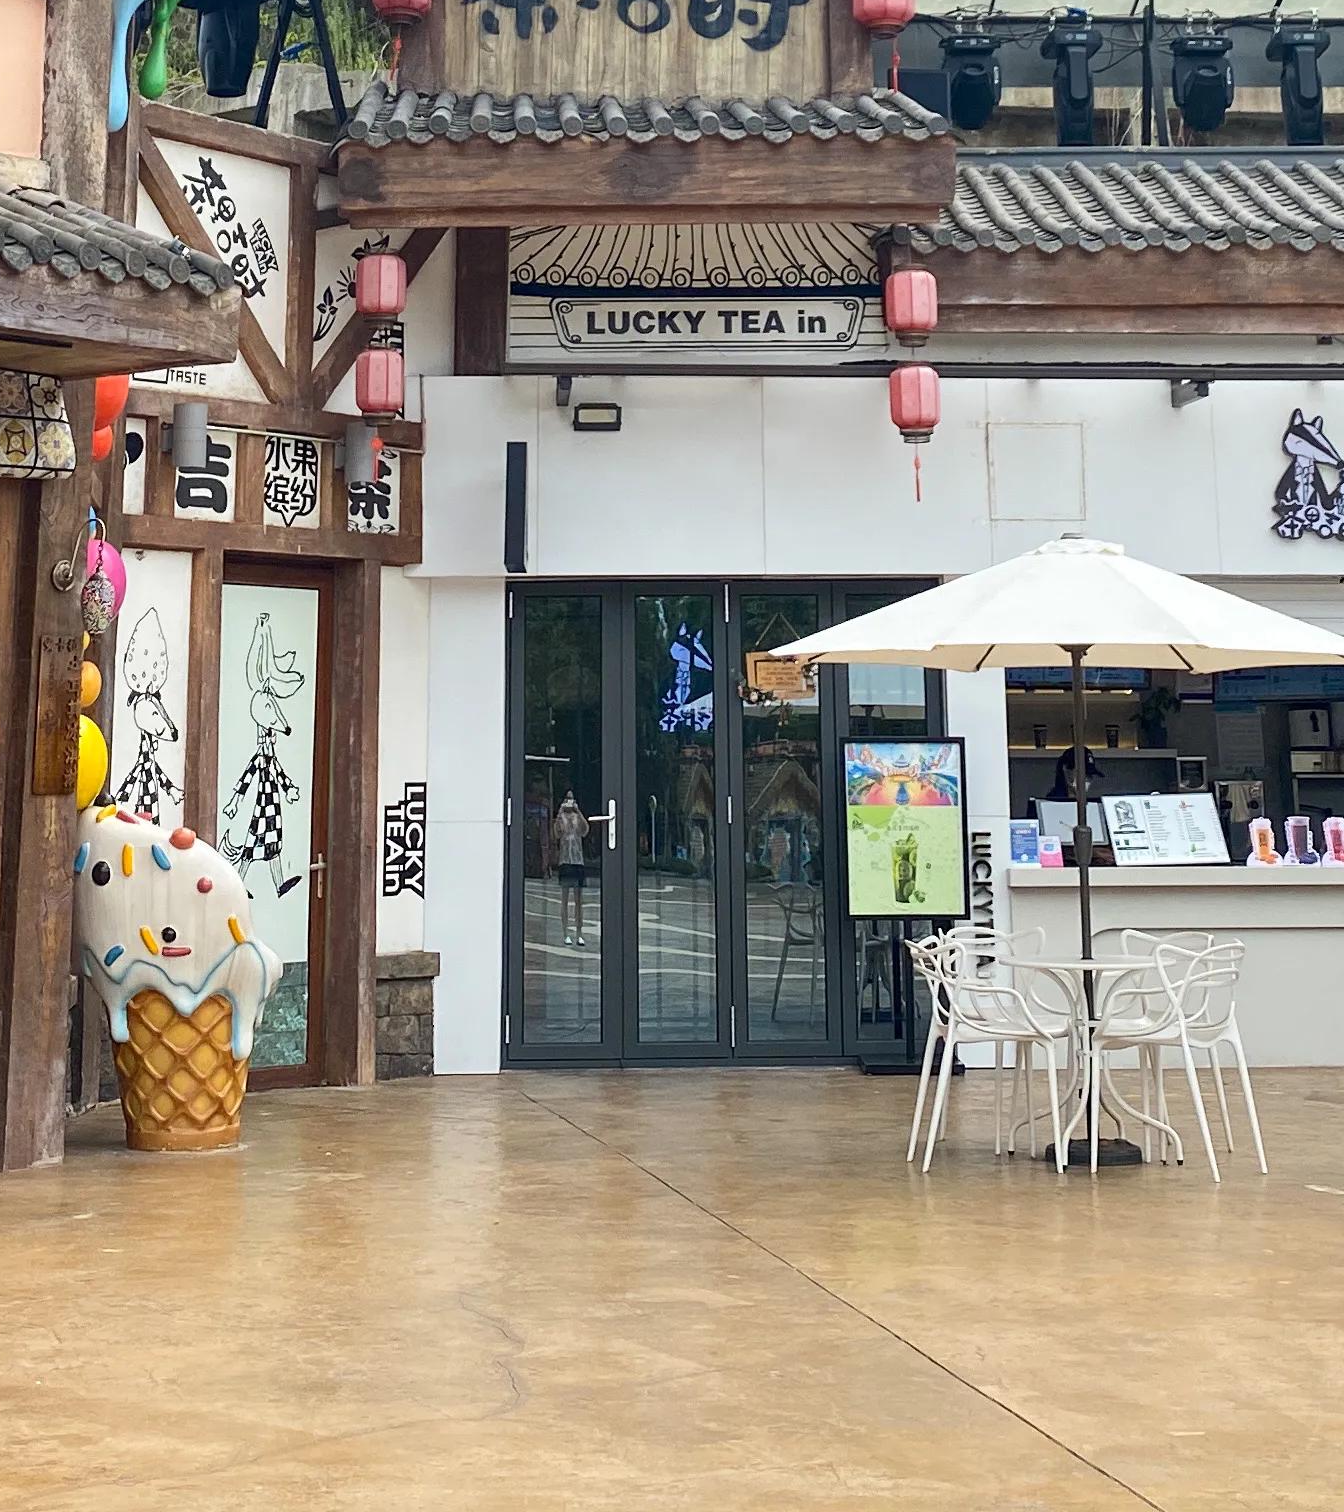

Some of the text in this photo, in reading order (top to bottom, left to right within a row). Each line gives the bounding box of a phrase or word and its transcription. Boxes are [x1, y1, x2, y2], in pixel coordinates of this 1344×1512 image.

[252, 218, 279, 272] LUCKY
[586, 310, 826, 335] LUCKY TEA in
[169, 369, 207, 386] TASTE
[265, 436, 318, 477] 水果
[264, 474, 317, 516] 缤纷
[385, 805, 405, 893] TEAin
[405, 786, 424, 892] LUCKY
